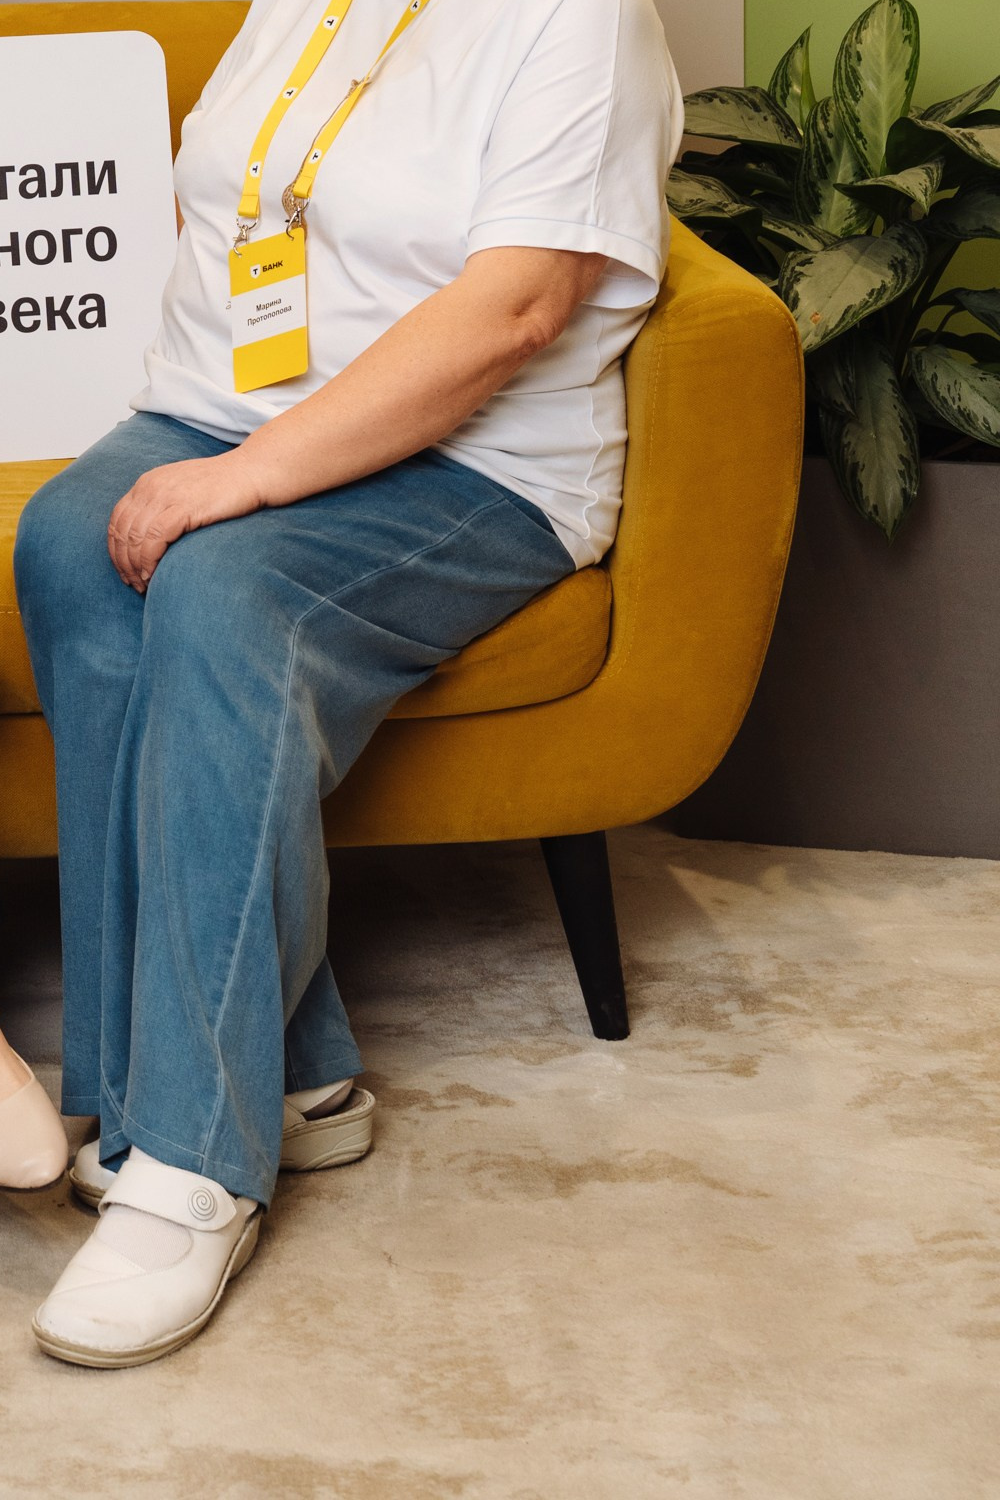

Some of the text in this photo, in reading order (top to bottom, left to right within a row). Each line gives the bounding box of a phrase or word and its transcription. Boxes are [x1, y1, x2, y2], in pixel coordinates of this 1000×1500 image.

[262, 260, 284, 272] БАНК
[255, 298, 282, 312] Марина
[247, 305, 292, 326] Протопопова
